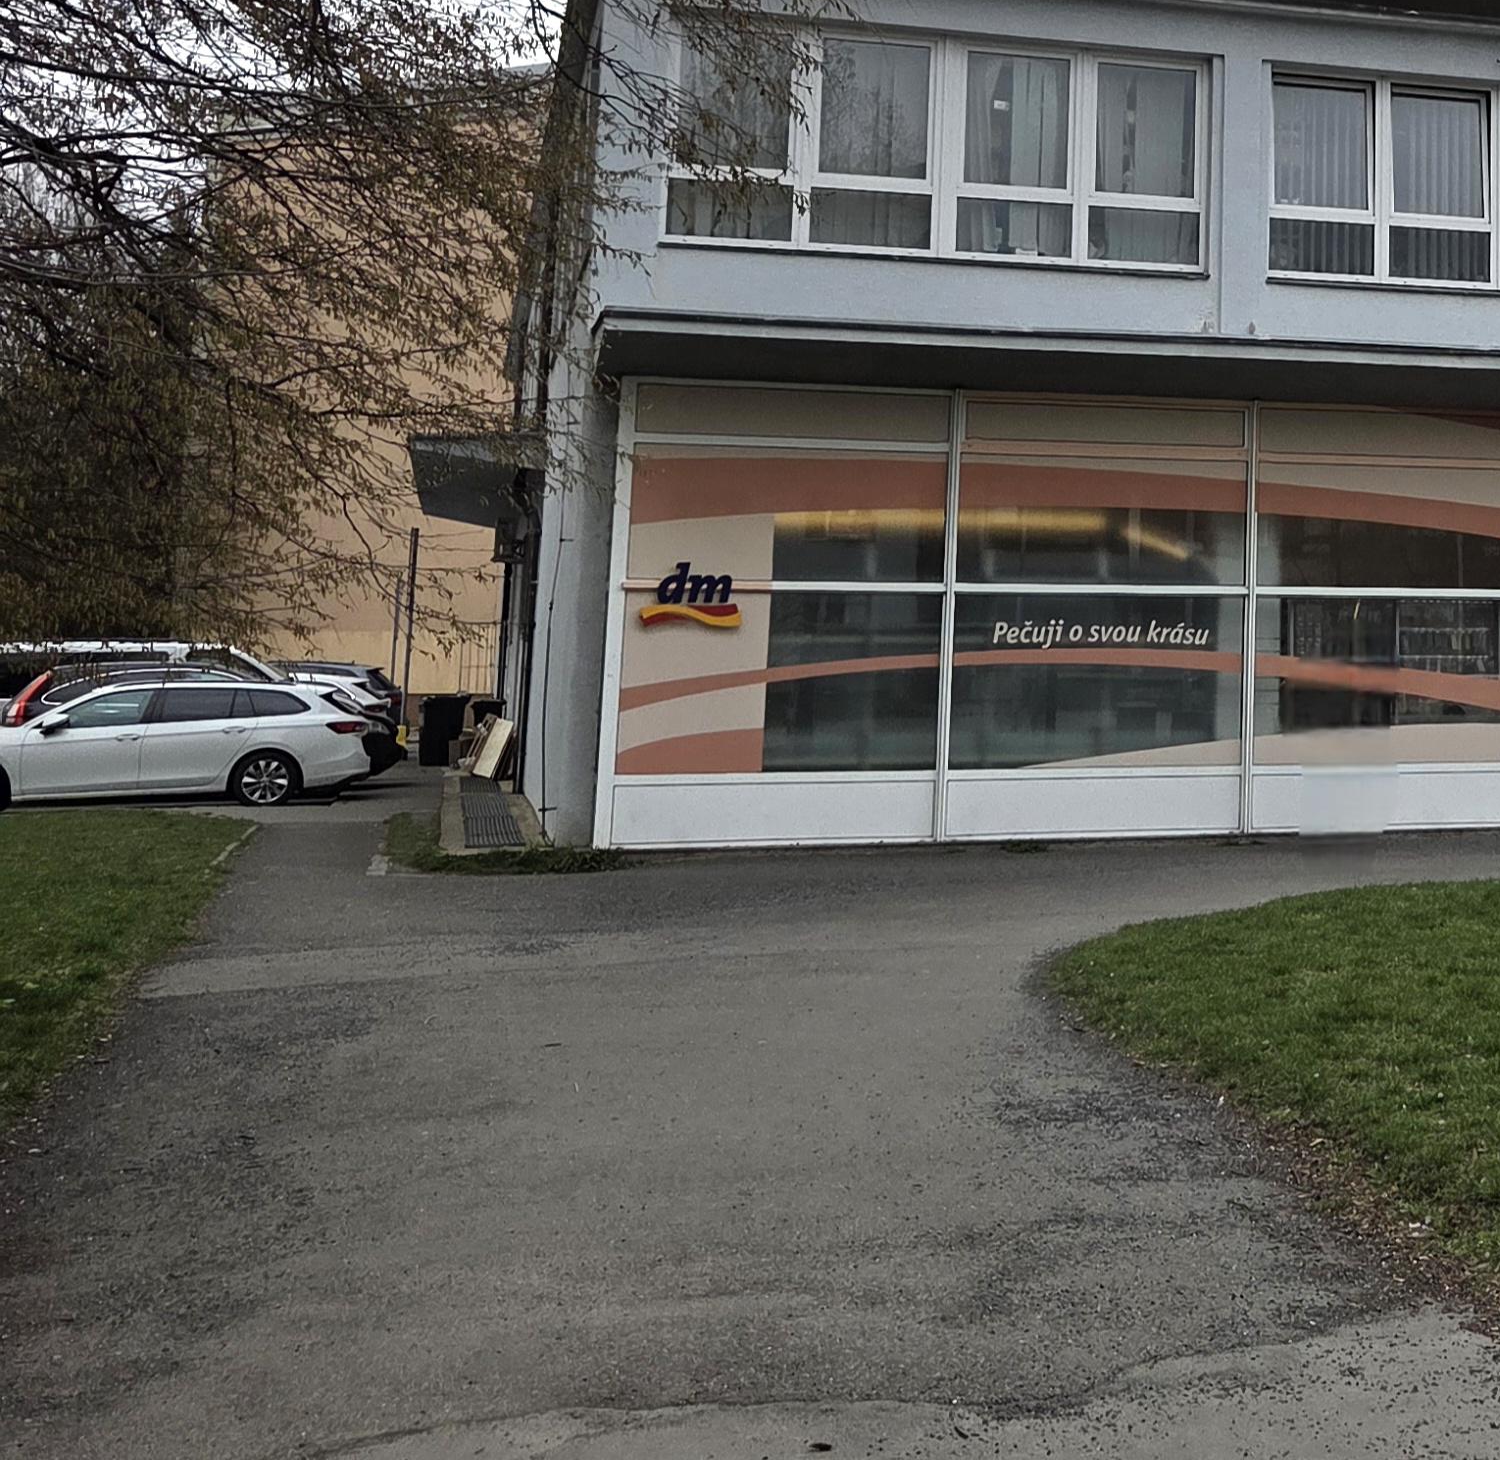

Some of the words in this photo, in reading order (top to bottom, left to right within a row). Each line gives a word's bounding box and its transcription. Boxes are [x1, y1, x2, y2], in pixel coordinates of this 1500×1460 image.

[657, 562, 732, 604] dm
[993, 619, 1064, 649] Pečuji
[1069, 625, 1082, 642] o
[1087, 624, 1141, 643] svou
[1146, 619, 1209, 646] krásu
